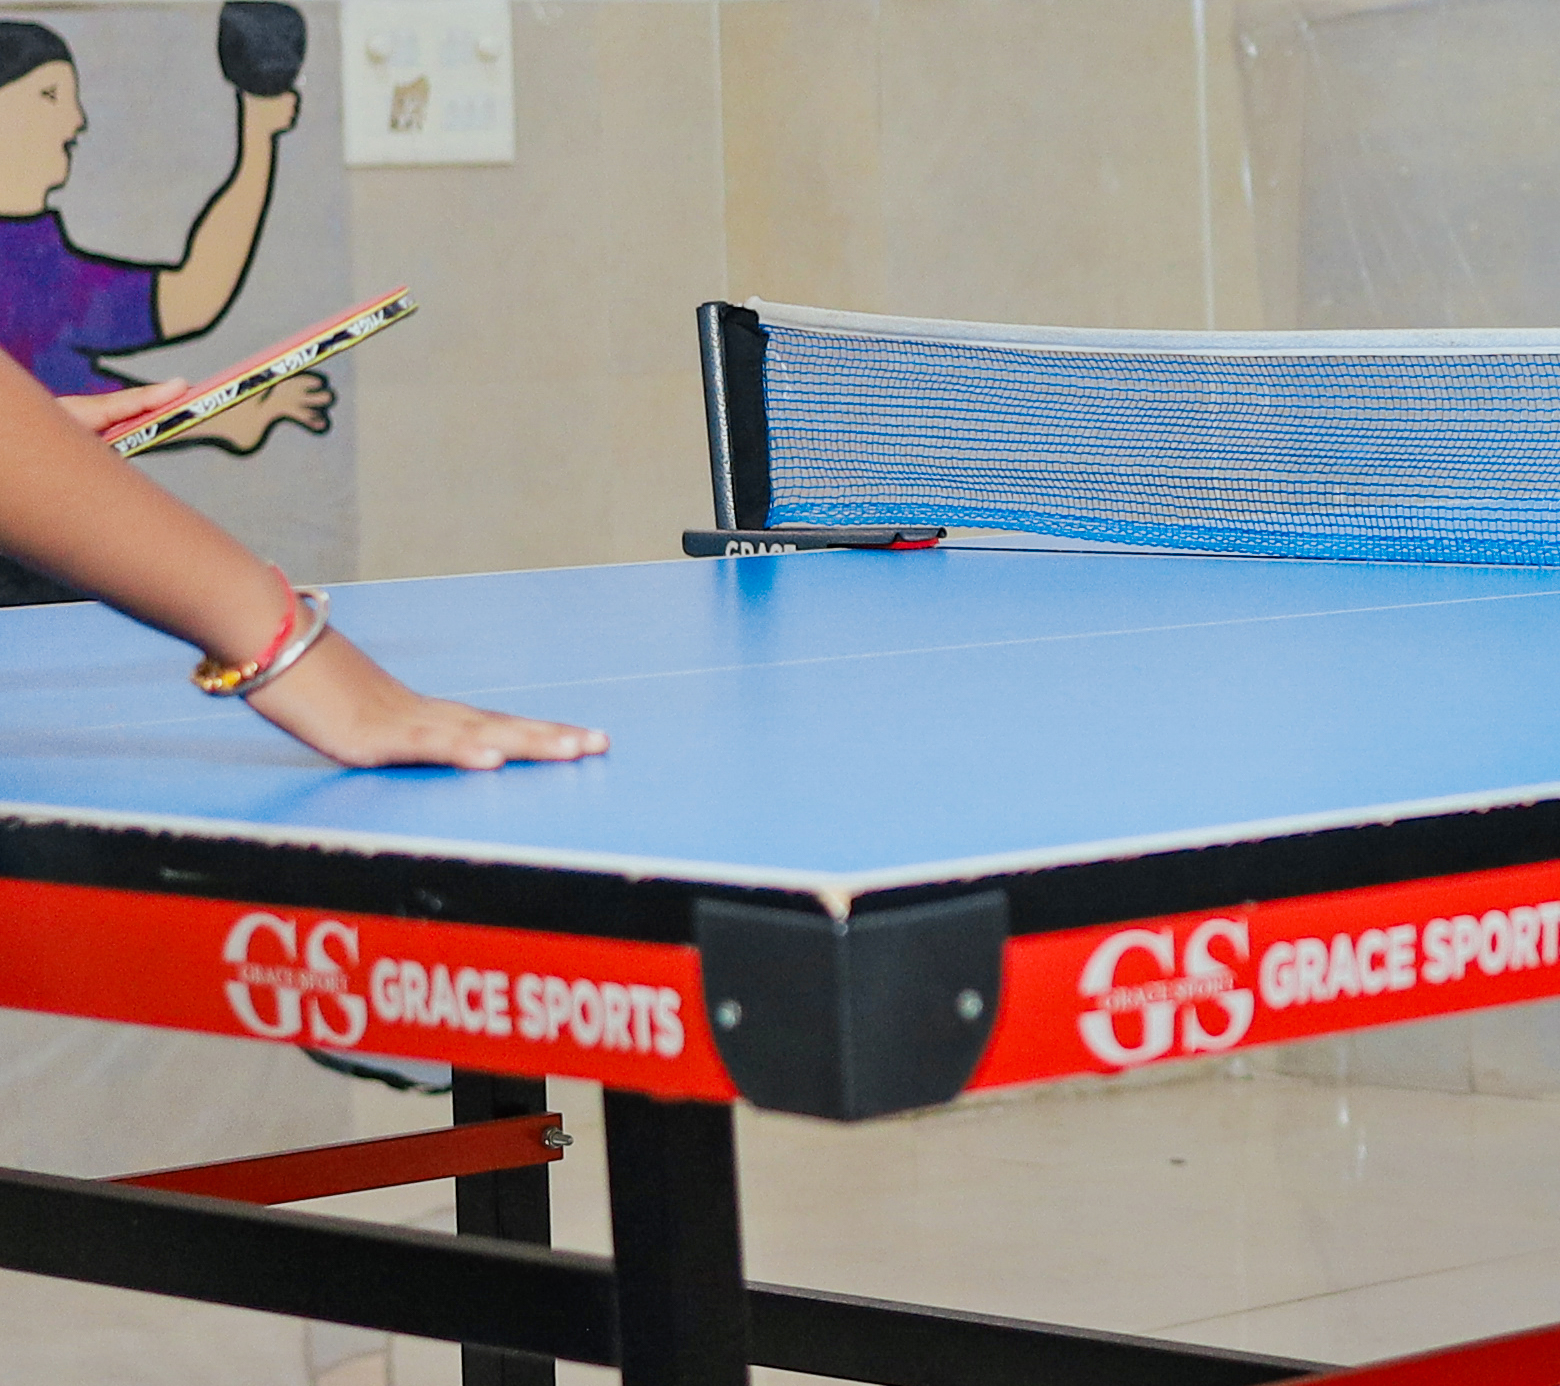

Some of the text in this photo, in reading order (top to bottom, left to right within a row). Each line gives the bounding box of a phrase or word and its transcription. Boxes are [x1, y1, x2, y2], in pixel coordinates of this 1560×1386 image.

[370, 957, 513, 1036] GRACE
[515, 971, 685, 1057] SPORTS
[1258, 921, 1417, 1010] GRACE
